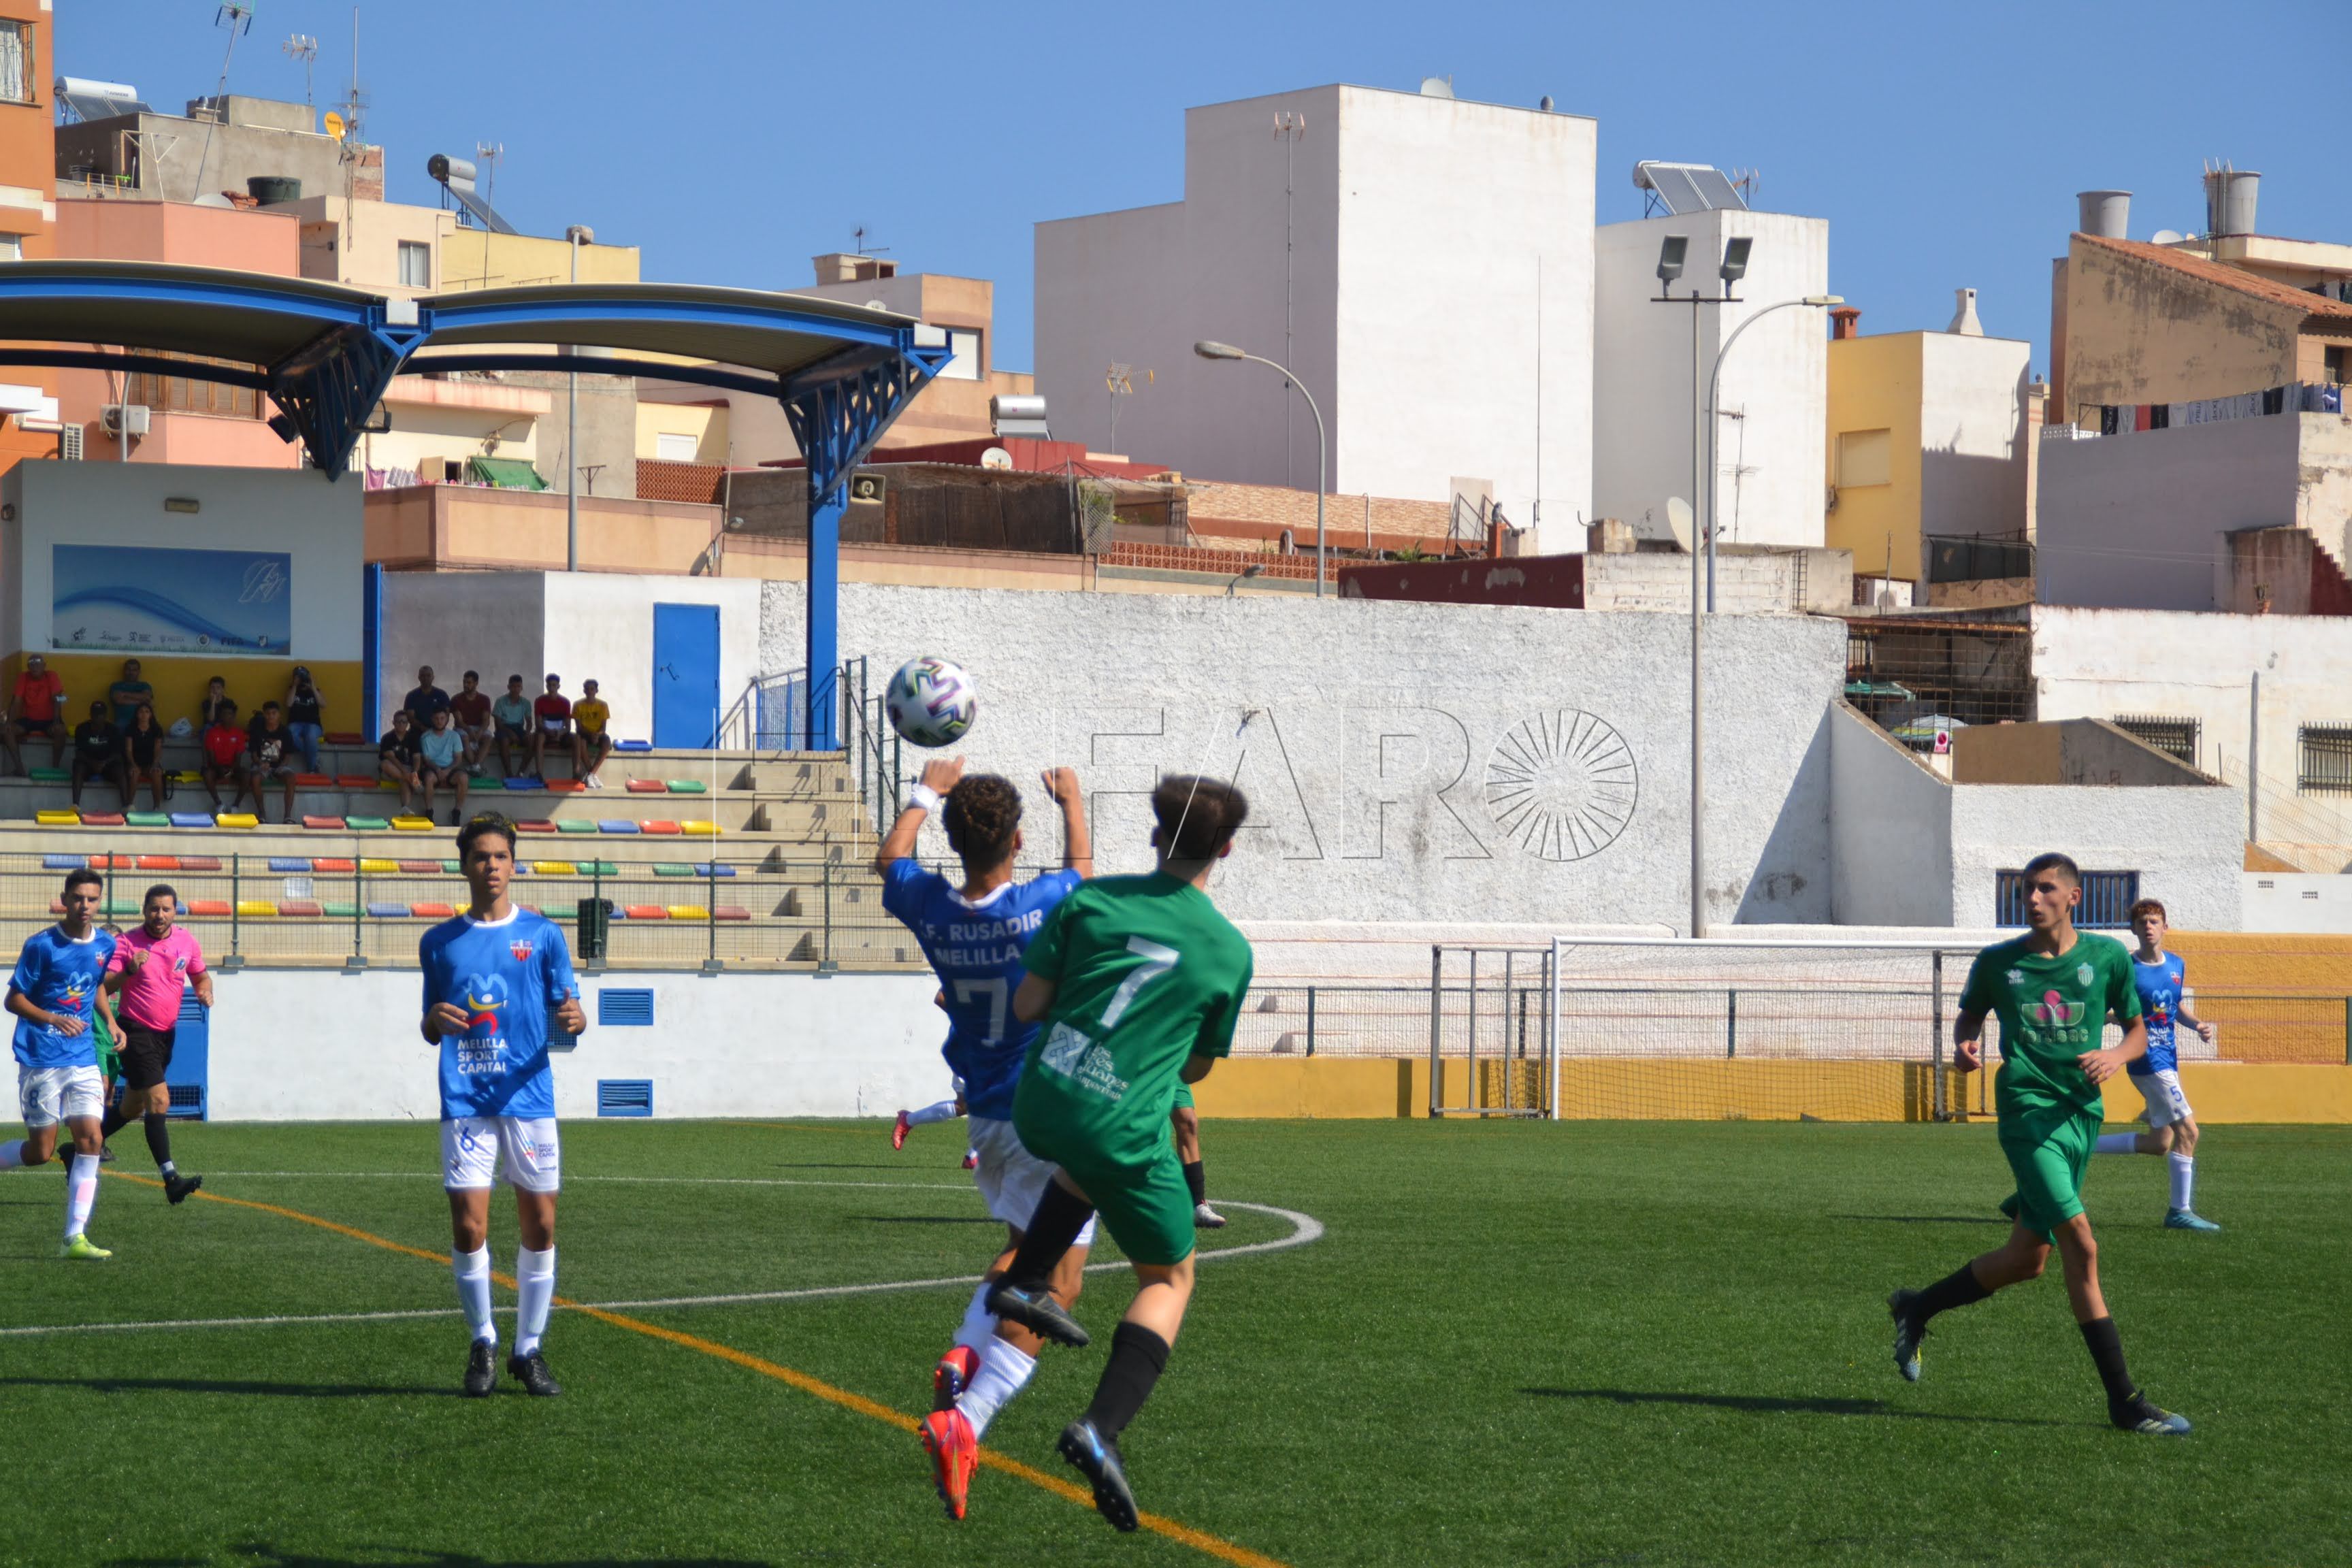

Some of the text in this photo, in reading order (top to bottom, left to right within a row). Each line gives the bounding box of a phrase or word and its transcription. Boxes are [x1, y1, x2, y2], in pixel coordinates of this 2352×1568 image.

[950, 909, 1043, 941] RUSADIR
[934, 944, 1022, 966] MELILLA
[1098, 934, 1181, 1028] 7
[953, 977, 1008, 1048] 7
[457, 1038, 508, 1049] MELILLA
[457, 1049, 499, 1062] SPORT
[29, 1090, 39, 1109] 8
[2170, 1085, 2183, 1102] 5
[460, 1126, 476, 1152] 6
